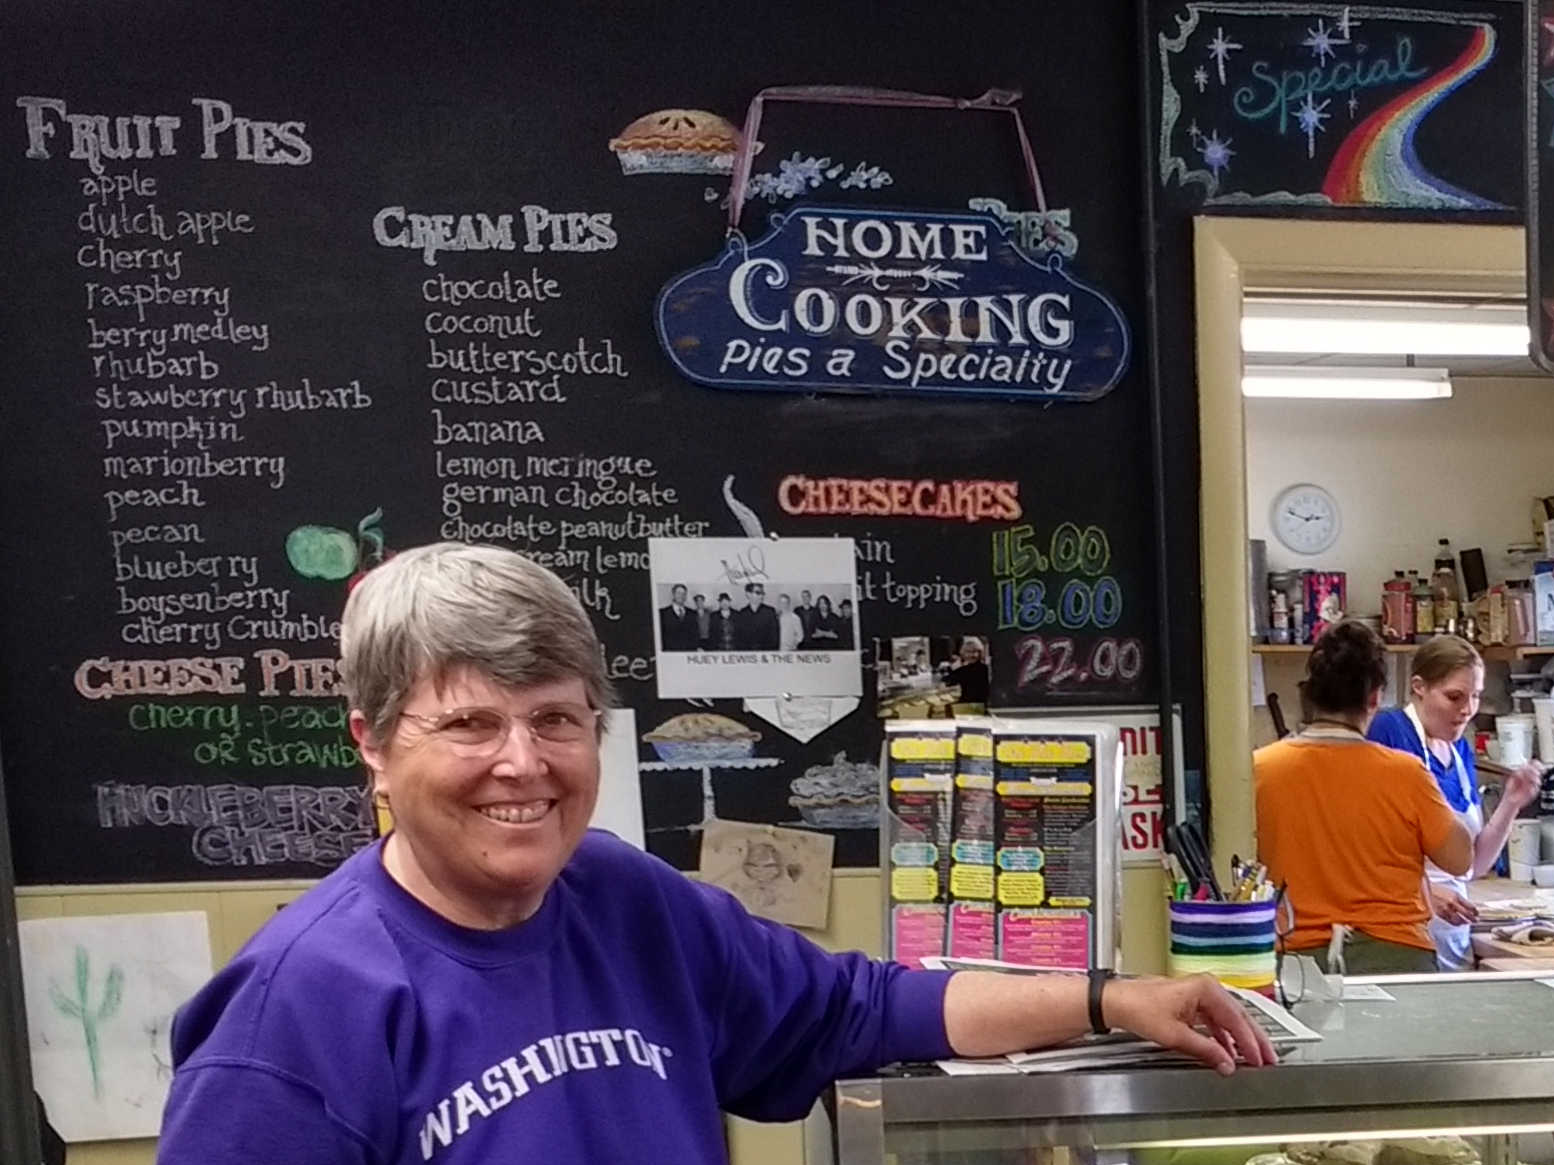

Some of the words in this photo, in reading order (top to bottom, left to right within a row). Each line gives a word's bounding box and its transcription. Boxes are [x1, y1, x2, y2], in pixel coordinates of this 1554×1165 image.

[1233, 37, 1427, 135] Special
[192, 98, 312, 165] PIES
[80, 170, 157, 204] apple
[78, 204, 173, 241] dutch
[177, 211, 254, 245] apple
[521, 205, 618, 252] PIES
[801, 216, 989, 261] HOME
[86, 275, 231, 322] raspberry
[422, 268, 562, 306] chocolate
[729, 258, 1075, 350] COOKING
[88, 318, 166, 355] berry
[172, 318, 269, 351] medley
[425, 308, 542, 338] coconut
[92, 351, 219, 380] rhubarb
[427, 338, 629, 377] butterscotch
[826, 348, 856, 377] a
[883, 340, 1073, 394] Specialty
[255, 379, 372, 411] rhubarb
[431, 375, 567, 404] custard
[101, 416, 244, 450] pumpkin
[431, 409, 545, 445] banana
[103, 451, 285, 488] marionberry
[436, 451, 518, 480] lemon
[104, 481, 205, 522] peach
[443, 483, 548, 517] german
[555, 481, 679, 511] chocolate
[777, 474, 1024, 522] CHEESECAKES
[111, 522, 204, 556] pecan
[441, 514, 556, 544] chocolate
[115, 550, 258, 587] blueberry
[525, 550, 590, 572] ream
[596, 545, 650, 574] lemo
[992, 521, 1111, 578] 15.00
[116, 585, 290, 624] boysenberry
[881, 572, 978, 616] topping
[998, 576, 1123, 631] 18.00
[121, 613, 222, 649] cherry
[74, 656, 246, 700] CHEESE
[687, 654, 718, 664] HUEY
[721, 654, 757, 664] LEWIS
[761, 654, 769, 664] &
[771, 654, 793, 664] THE
[797, 654, 832, 664] NEWS
[1016, 633, 1143, 688] 22.00
[94, 781, 376, 832] HUCKLEBERRY
